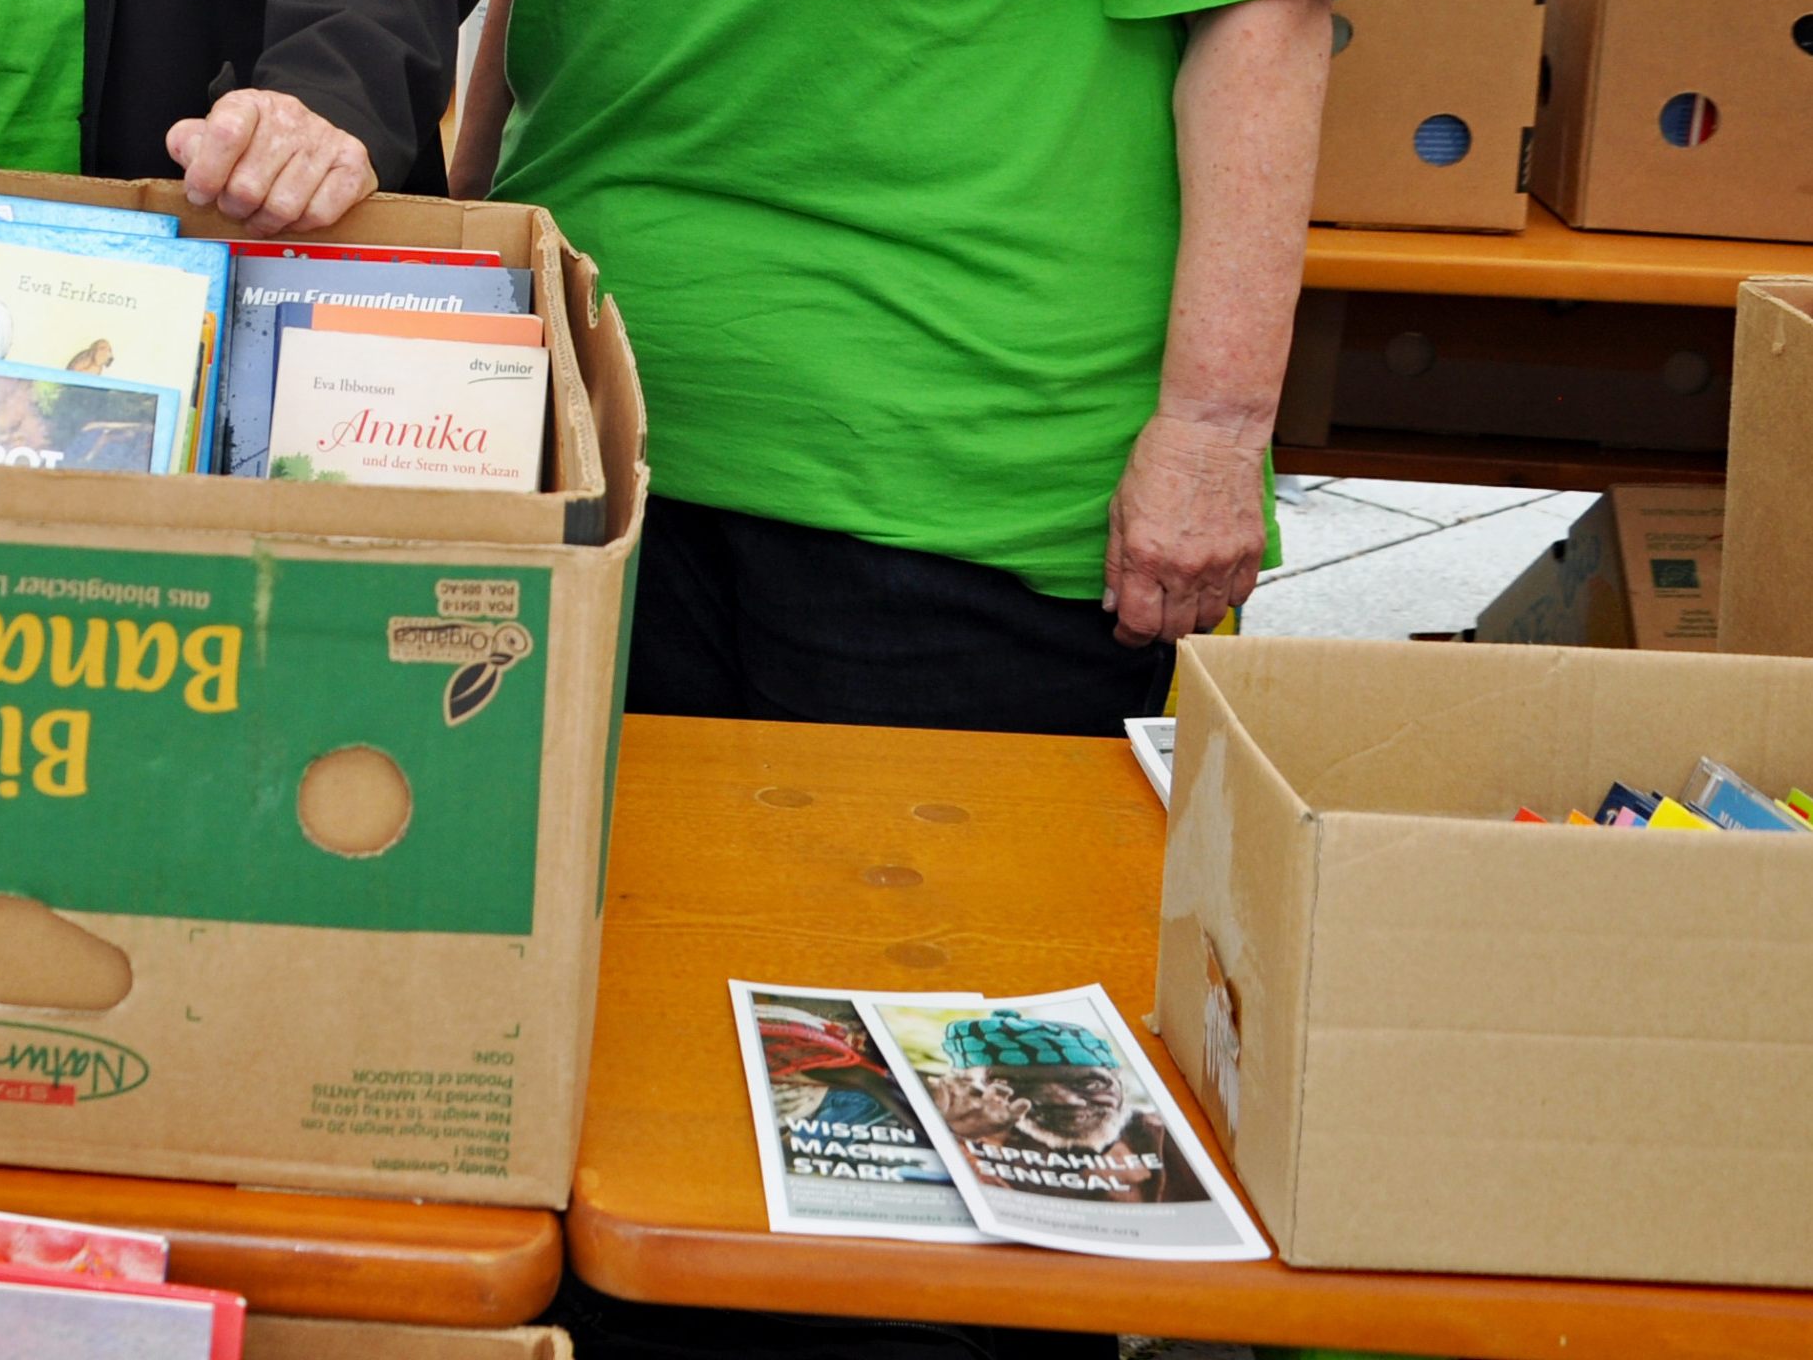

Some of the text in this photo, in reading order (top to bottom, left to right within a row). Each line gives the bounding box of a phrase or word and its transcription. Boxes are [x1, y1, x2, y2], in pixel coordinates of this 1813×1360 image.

[18, 275, 138, 310] Eva Eriksson
[242, 287, 299, 306] Mein
[469, 359, 533, 375] dtv junior
[313, 376, 395, 396] Eva Ibbotson
[316, 408, 488, 454] Annika
[362, 456, 519, 478] und der Stern von Kazan
[14, 576, 160, 607] biologischer
[167, 588, 211, 610] aus
[352, 1070, 512, 1088] Product of ECUADOR
[312, 1084, 512, 1106] Exported by: MARPLANTIS
[334, 1103, 358, 1117] (40
[363, 1104, 380, 1118] kg
[430, 1107, 481, 1122] weight:
[485, 1112, 511, 1125] Net
[300, 1119, 510, 1143] Minimum finger length 20 cm
[787, 1118, 916, 1144] WISSEN
[463, 1146, 510, 1161] Class:
[791, 1136, 915, 1163] MACHT
[965, 1140, 1164, 1171] LEPRAHILFE
[372, 1159, 508, 1178] Variety: Cavendish
[793, 1157, 905, 1183] STARK
[976, 1160, 1130, 1191] SENEGAL
